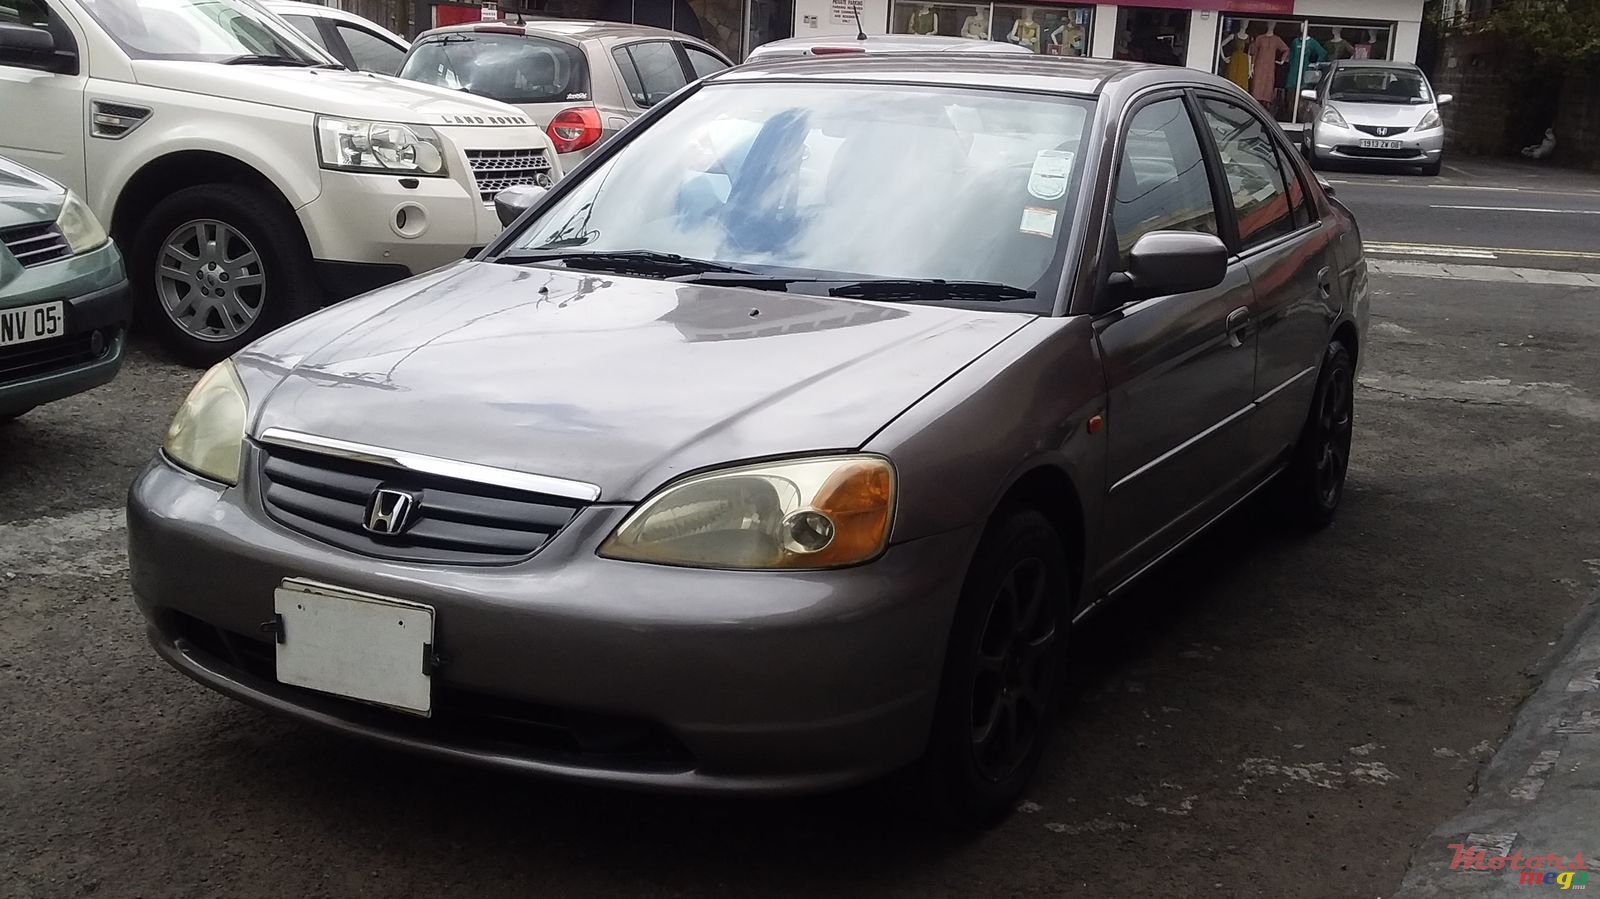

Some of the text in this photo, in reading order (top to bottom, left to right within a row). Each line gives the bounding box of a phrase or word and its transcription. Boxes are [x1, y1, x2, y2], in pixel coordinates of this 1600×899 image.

[441, 115, 527, 124] LAND ROVER
[1, 305, 57, 342] NV 05
